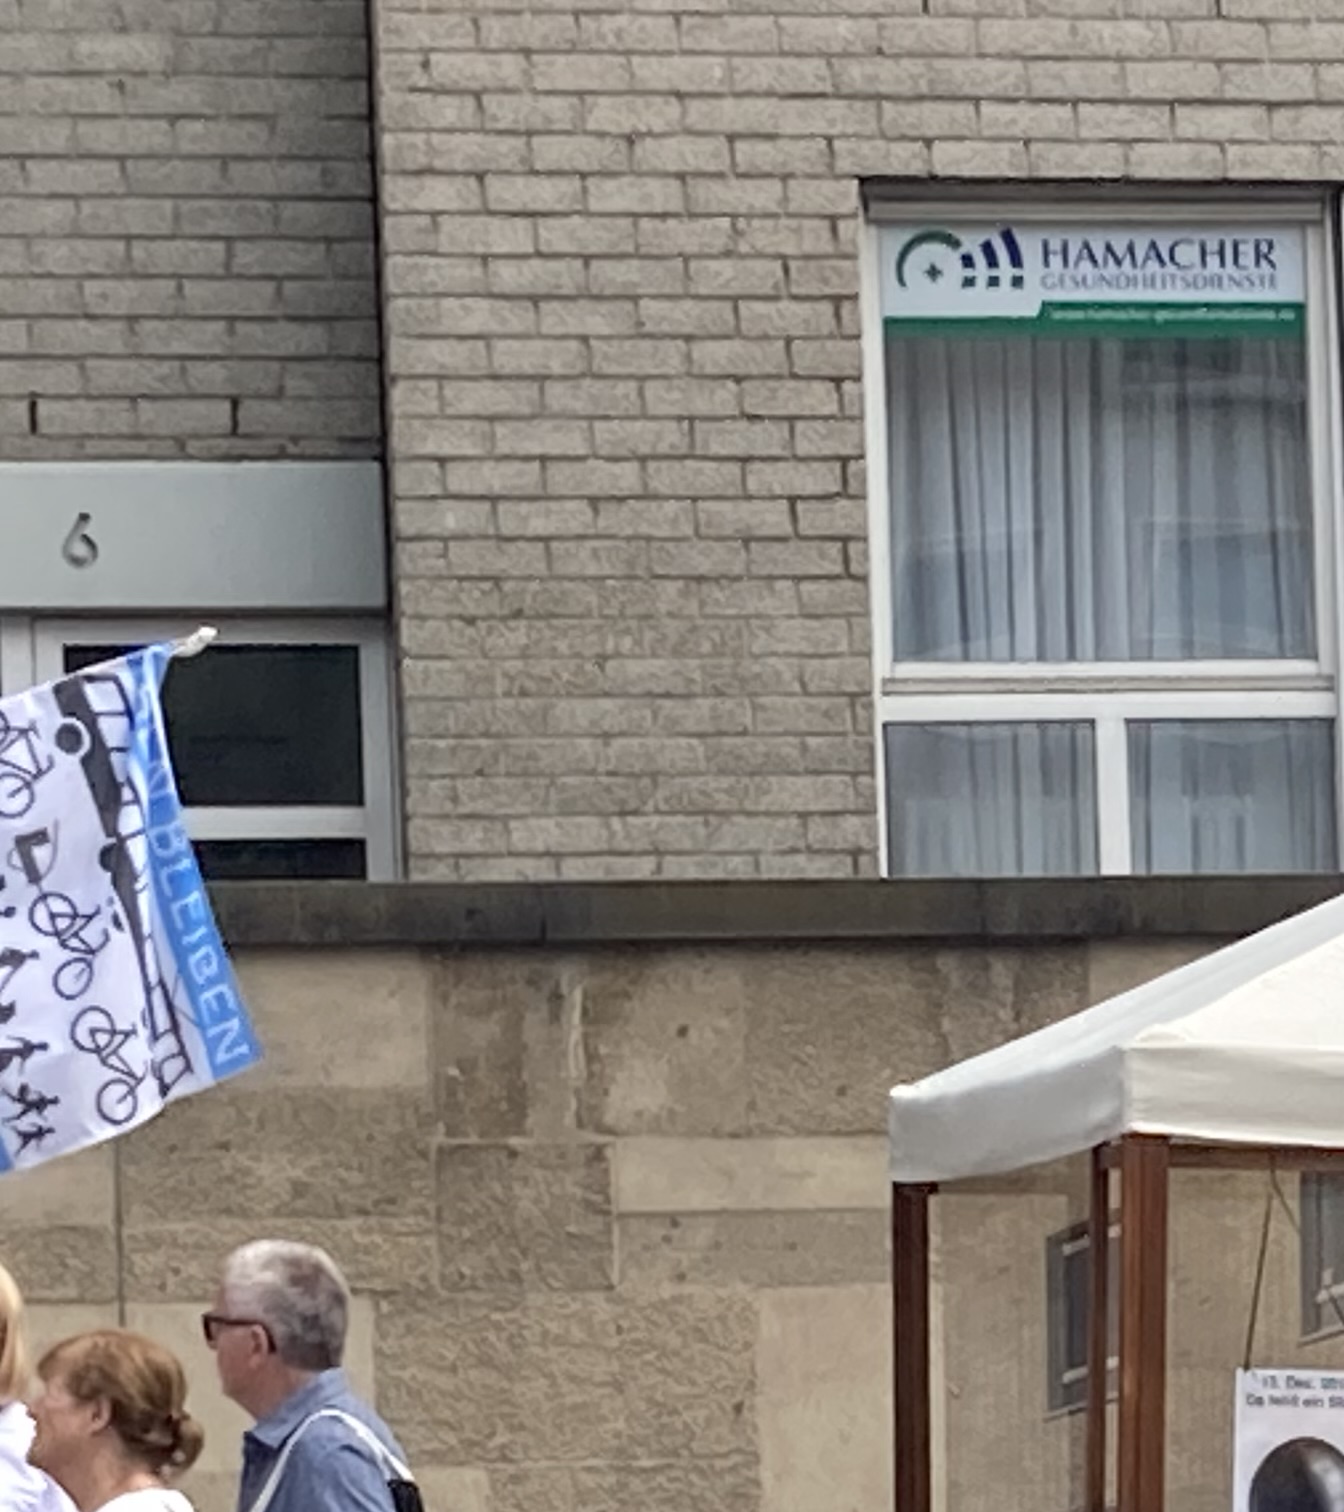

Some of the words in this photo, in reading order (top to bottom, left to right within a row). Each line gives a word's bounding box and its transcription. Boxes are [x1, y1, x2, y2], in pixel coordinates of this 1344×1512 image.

[1040, 237, 1278, 270] HAMACHER
[1040, 271, 1278, 291] GESUNDHEITSDIENSTE
[62, 512, 98, 569] 6
[150, 825, 252, 1070] BLEIBEN
